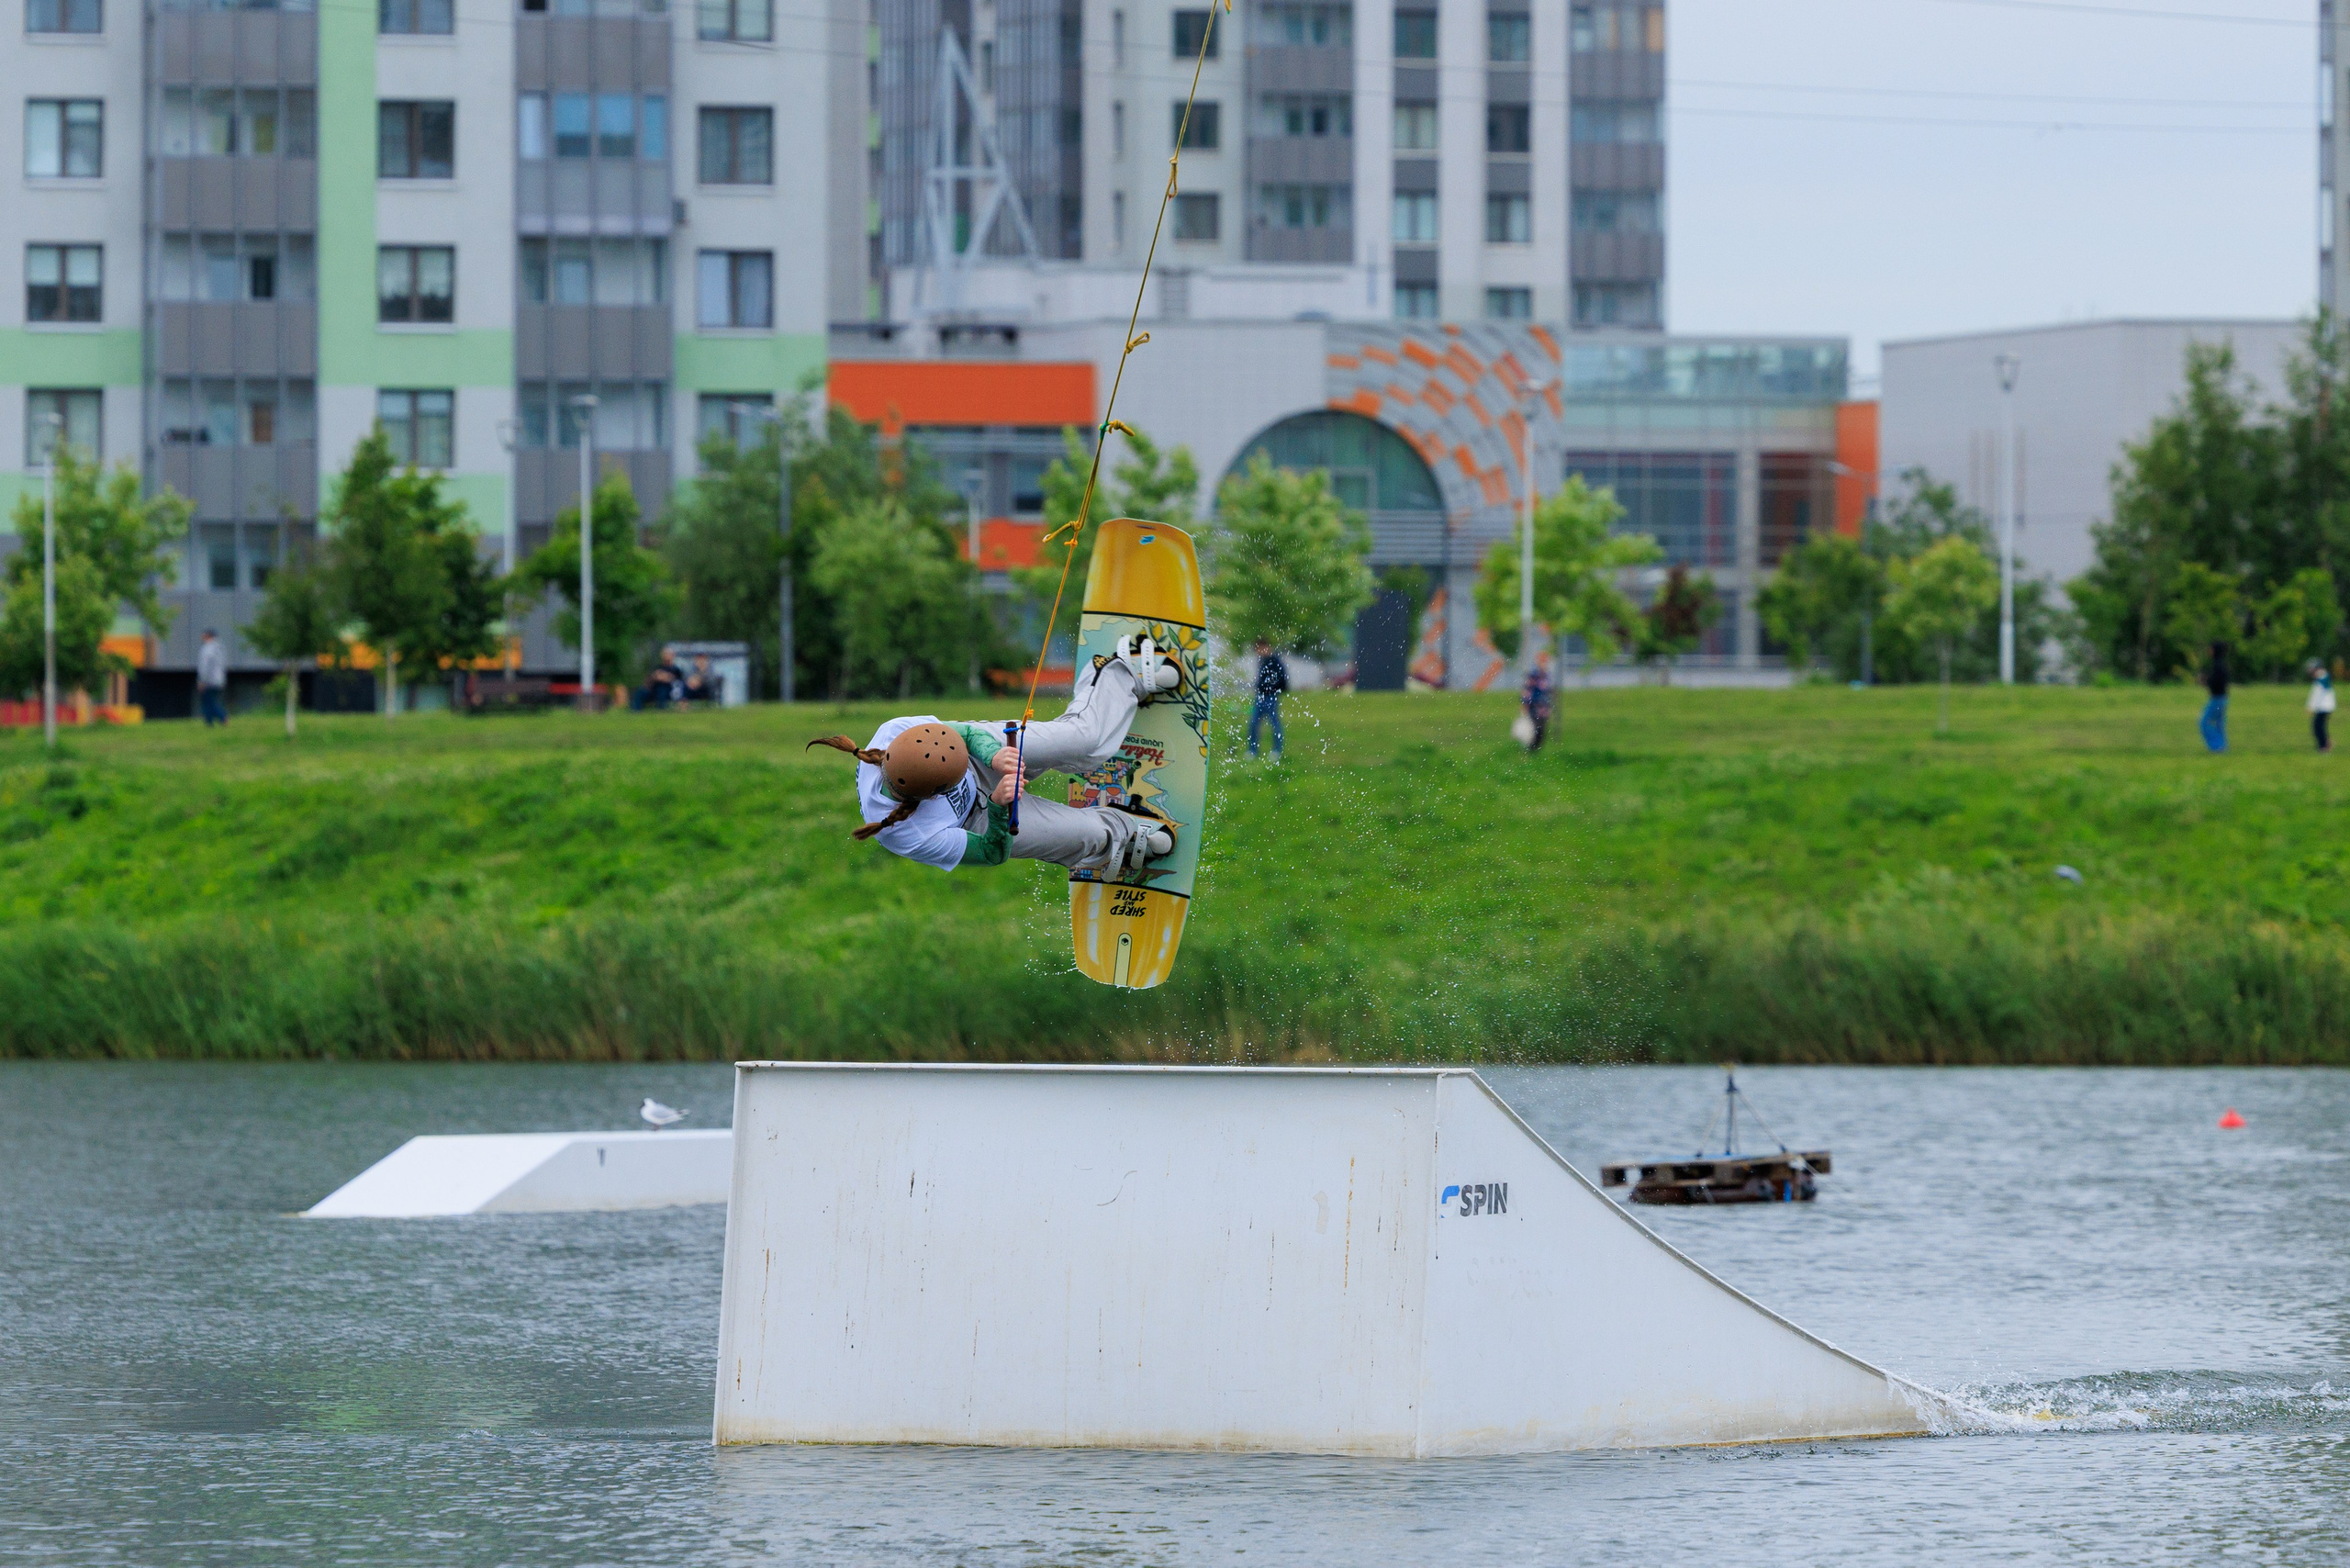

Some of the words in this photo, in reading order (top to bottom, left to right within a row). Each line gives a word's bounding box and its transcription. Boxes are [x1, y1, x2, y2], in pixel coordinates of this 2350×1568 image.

[1124, 735, 1140, 744] FOR
[1141, 738, 1164, 748] LIQUID
[1119, 744, 1164, 766] Holida
[1113, 889, 1147, 902] STYLE
[1110, 904, 1147, 917] SHRED
[1460, 1182, 1508, 1216] SPIN
